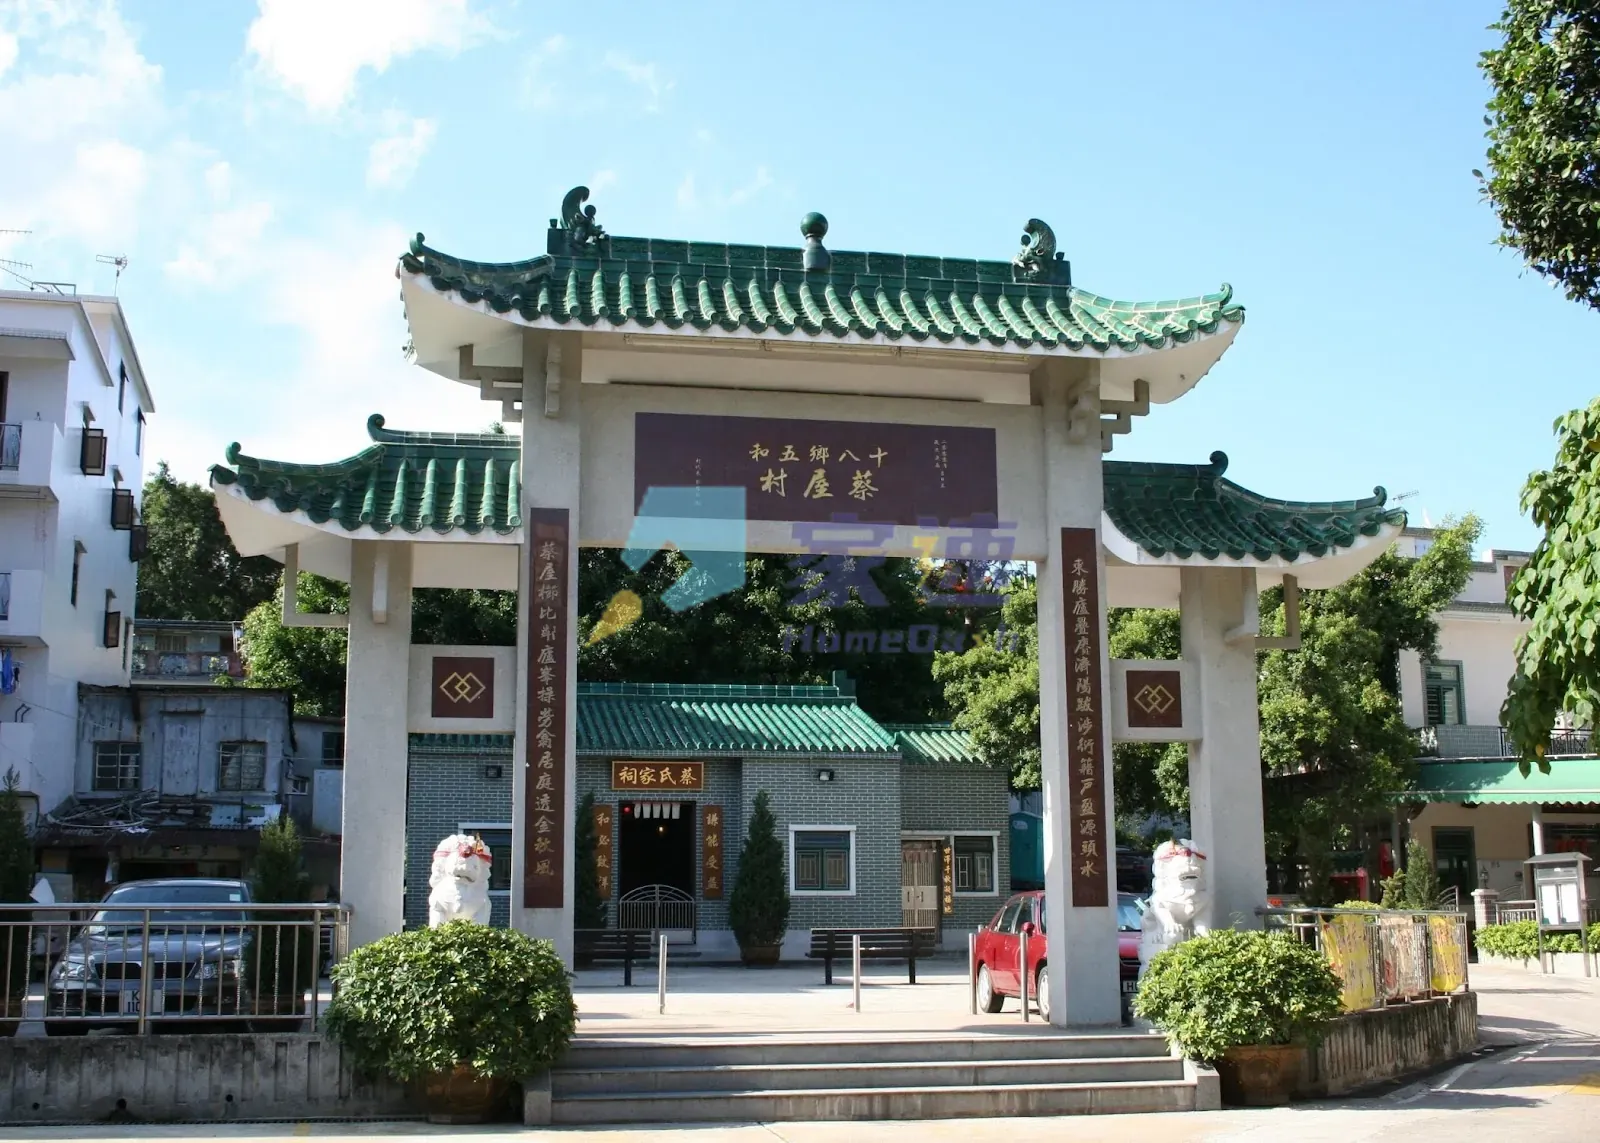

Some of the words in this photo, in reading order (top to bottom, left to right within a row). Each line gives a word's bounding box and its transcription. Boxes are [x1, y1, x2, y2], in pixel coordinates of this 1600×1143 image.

[748, 442, 889, 468] 十八鄉五和
[759, 468, 880, 501] 蔡屋村
[618, 766, 698, 786] 蔡氏家祠
[705, 812, 720, 890] 謙能受益
